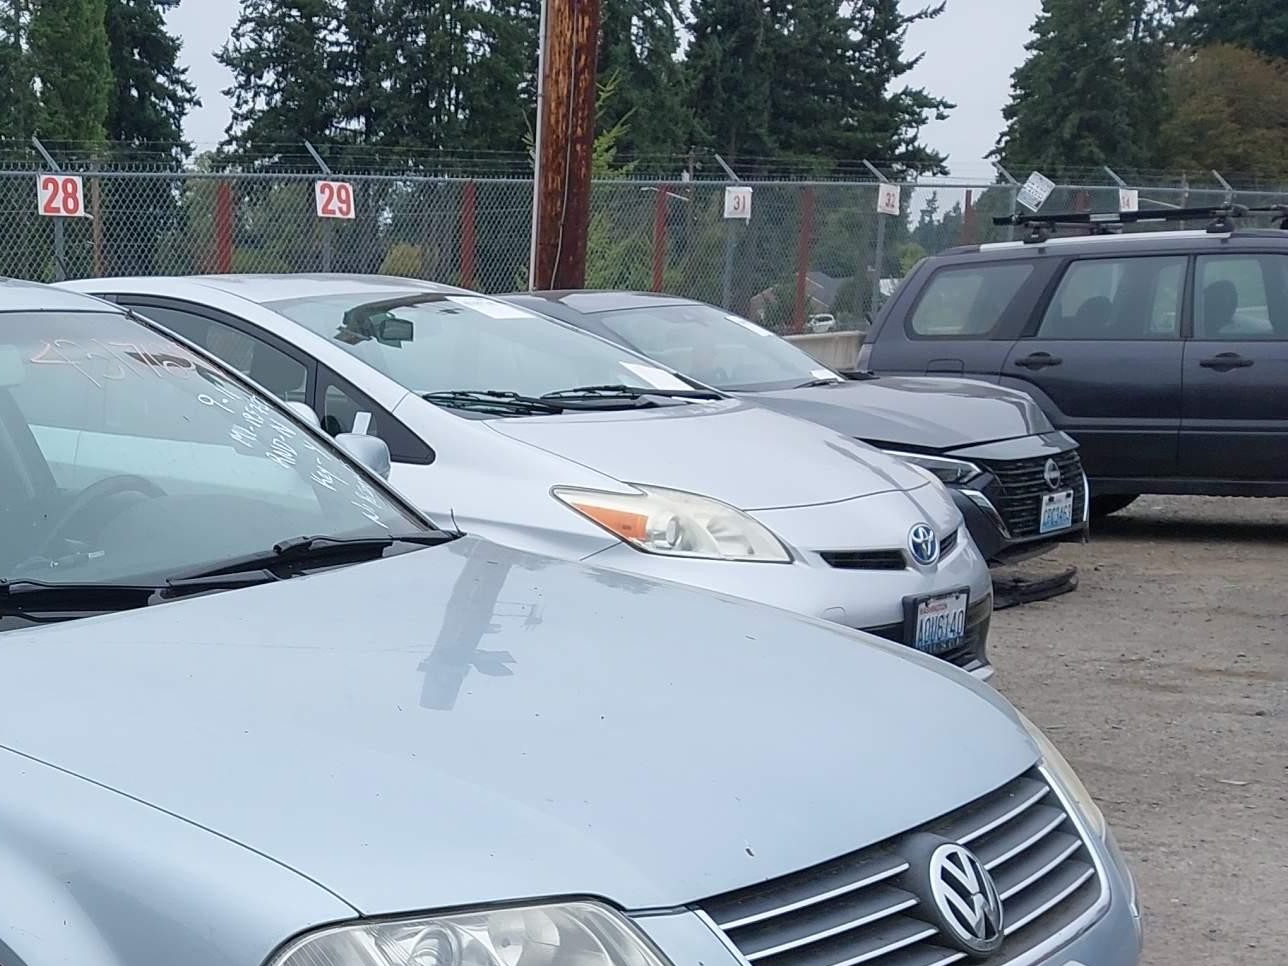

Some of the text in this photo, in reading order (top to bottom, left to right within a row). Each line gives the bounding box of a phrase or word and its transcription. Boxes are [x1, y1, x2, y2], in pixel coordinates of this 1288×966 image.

[42, 176, 79, 214] 28
[320, 183, 351, 217] 29
[733, 194, 746, 211] 31
